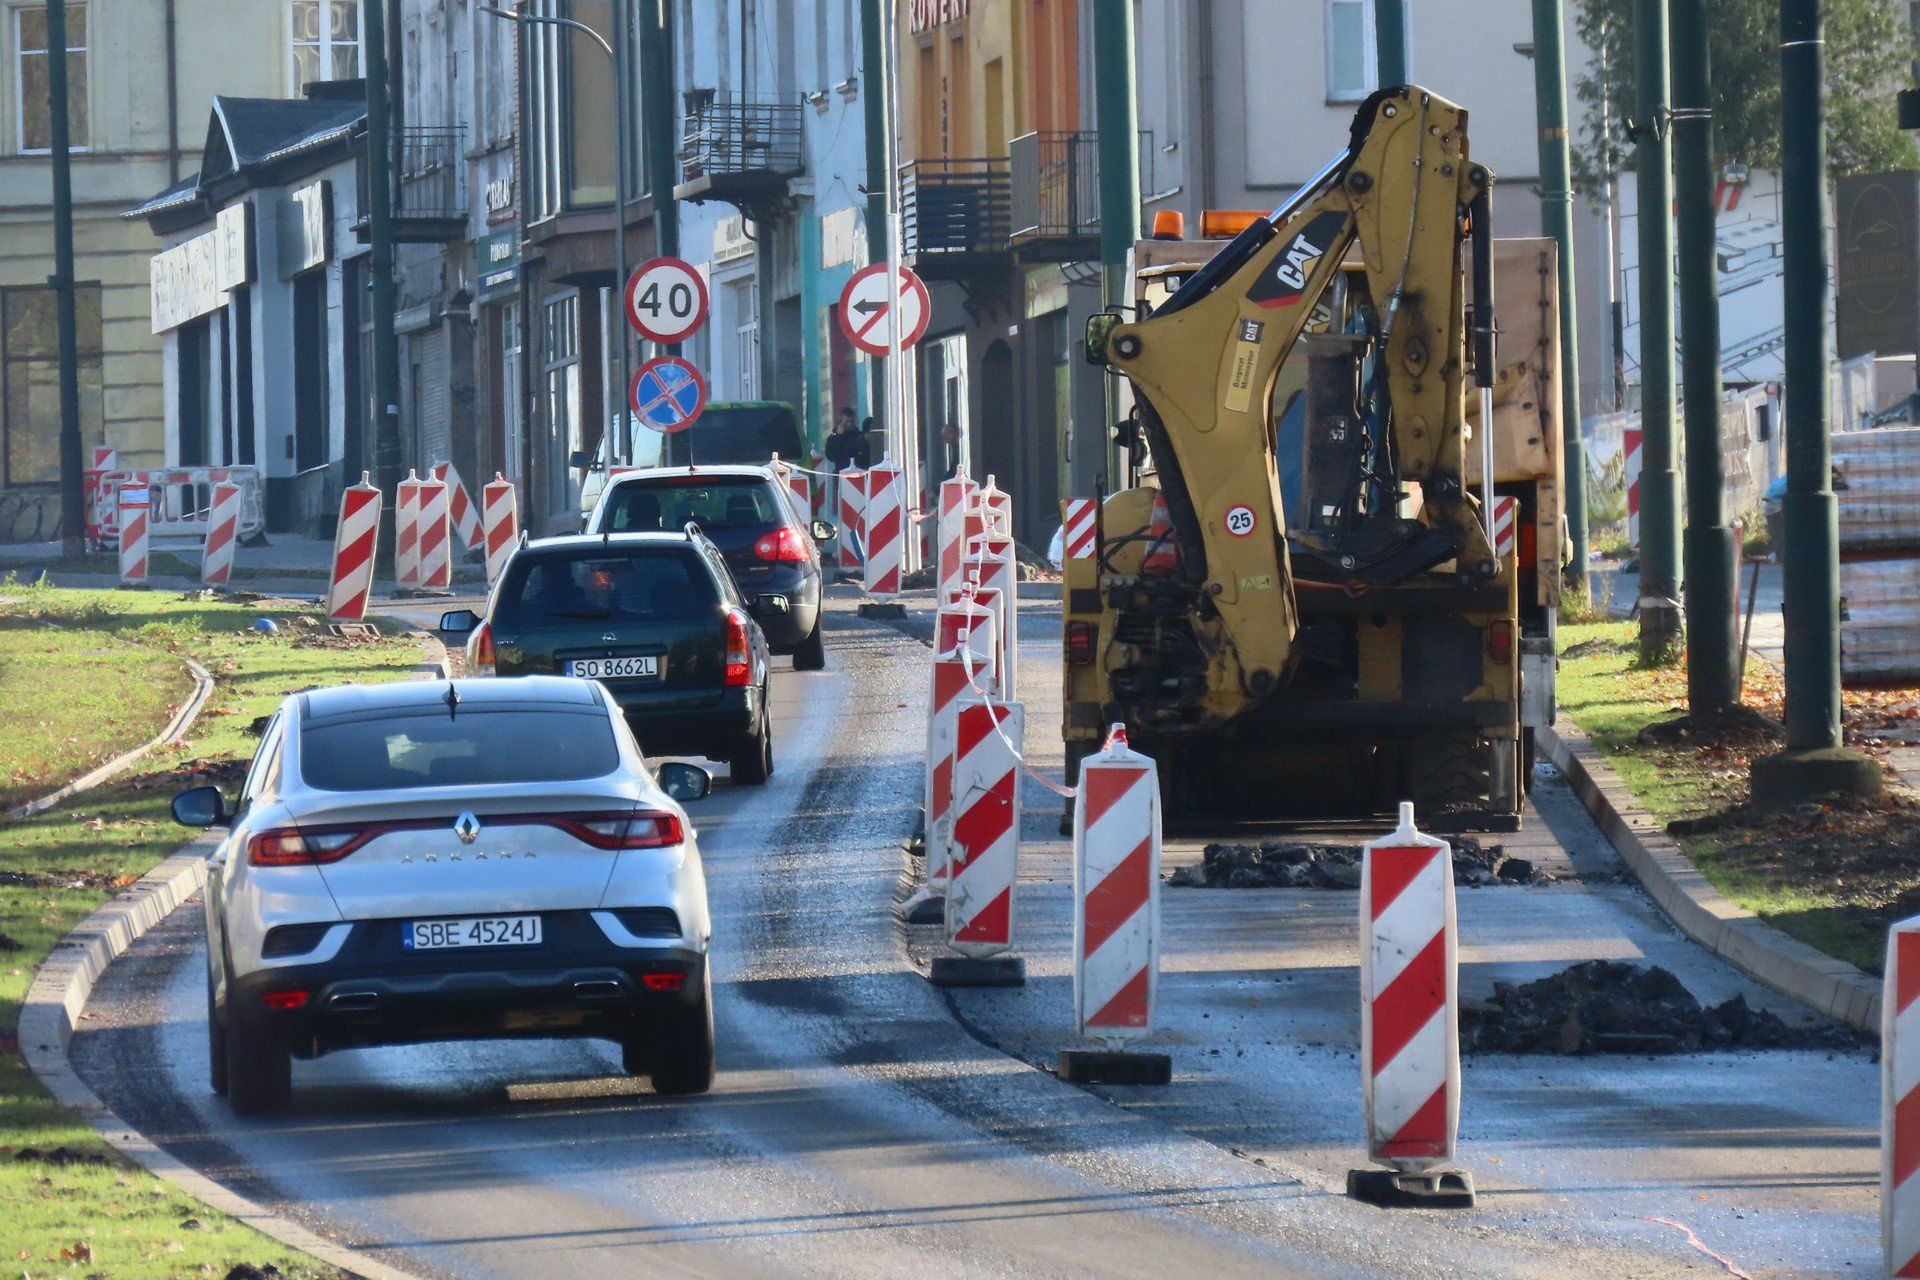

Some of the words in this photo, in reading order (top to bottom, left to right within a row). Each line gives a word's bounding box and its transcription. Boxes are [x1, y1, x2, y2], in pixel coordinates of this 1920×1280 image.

[1277, 233, 1323, 289] CAT
[638, 283, 692, 317] 40
[1245, 320, 1259, 341] CAT
[1230, 512, 1251, 530] 25
[575, 661, 598, 678] SO
[604, 658, 655, 676] 8662L
[401, 849, 537, 864] ARKANA
[415, 922, 460, 947] SBE
[468, 918, 537, 944] 4524J
